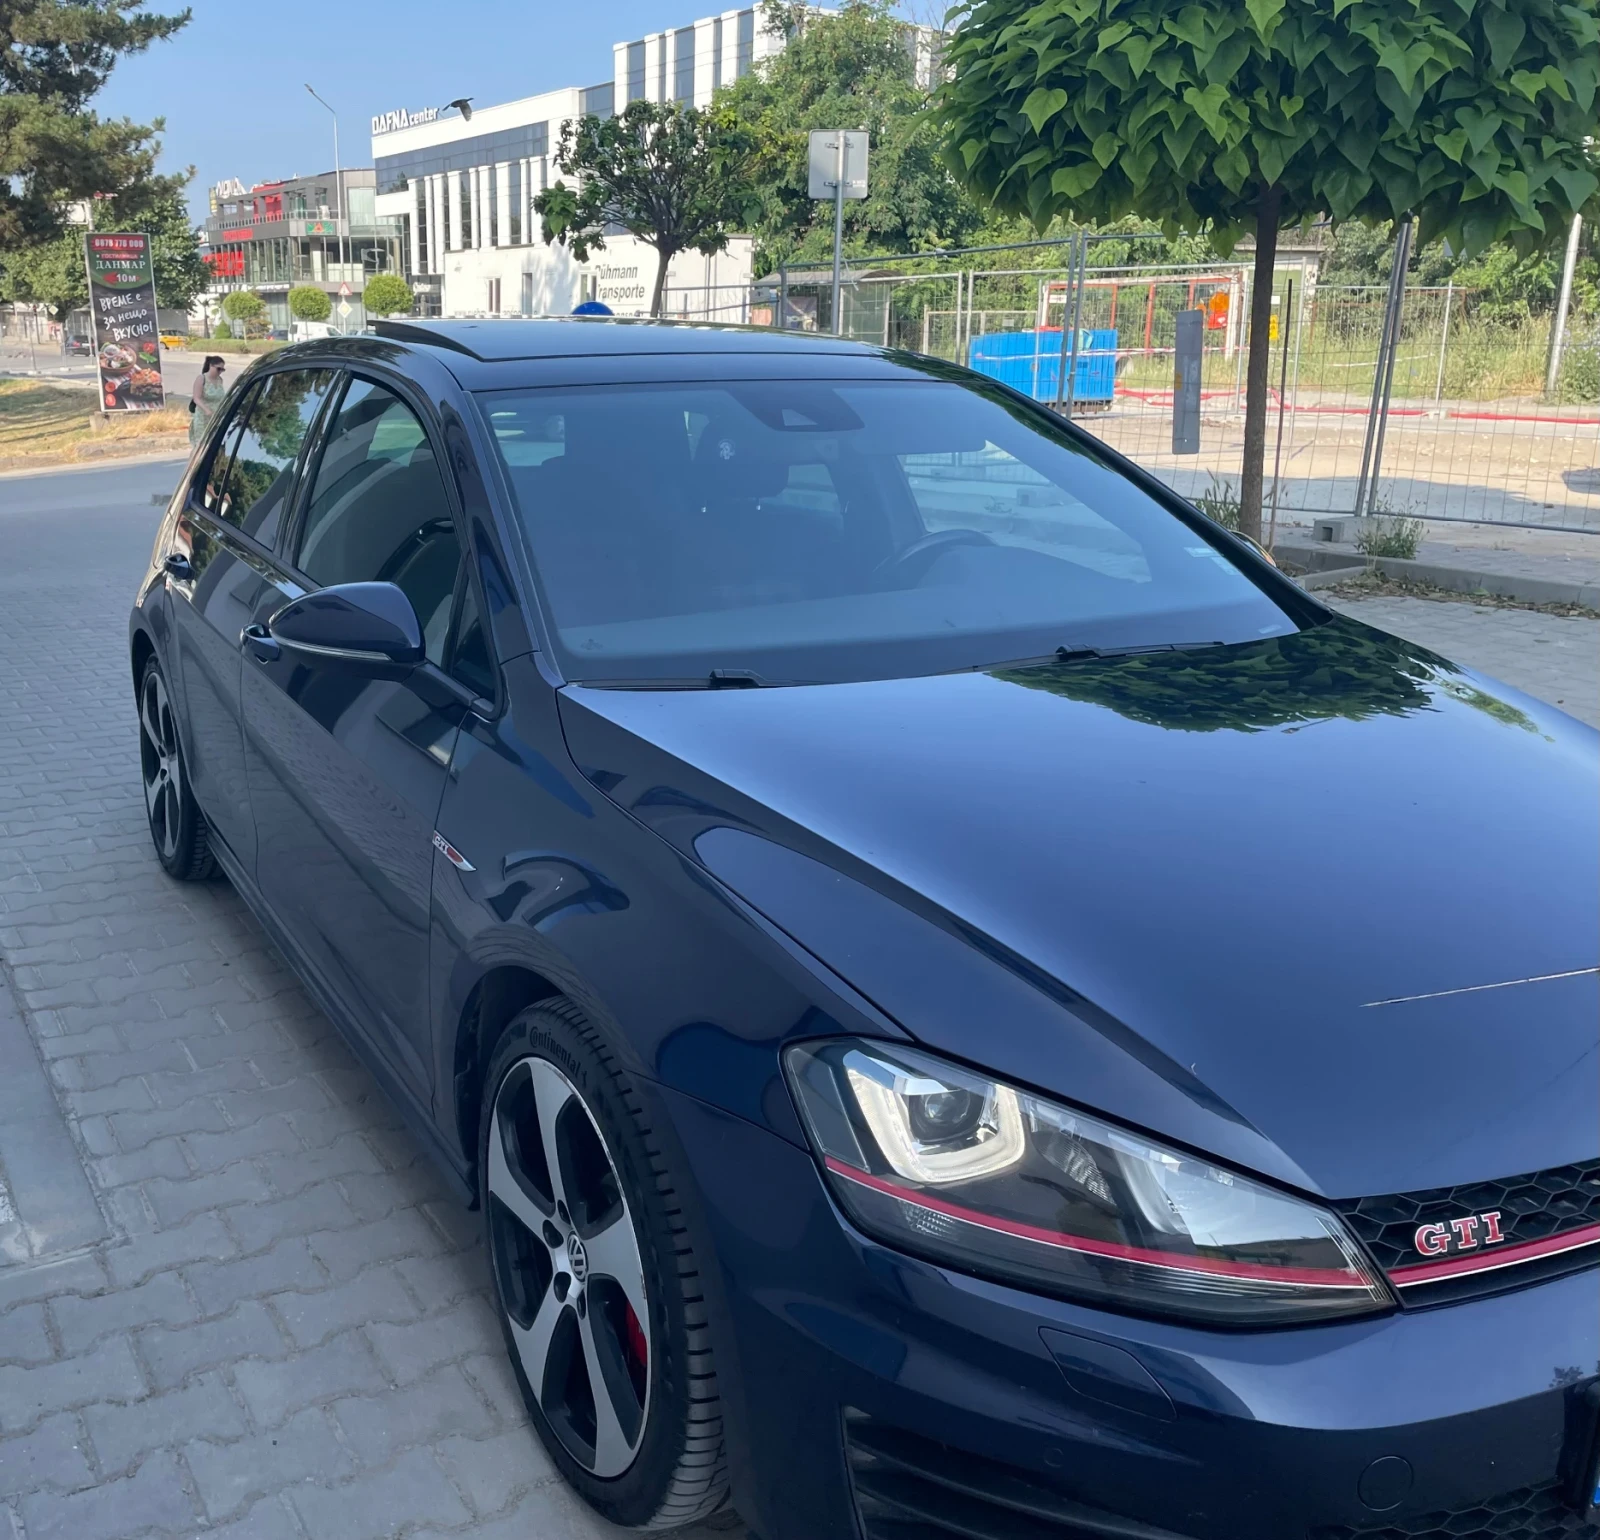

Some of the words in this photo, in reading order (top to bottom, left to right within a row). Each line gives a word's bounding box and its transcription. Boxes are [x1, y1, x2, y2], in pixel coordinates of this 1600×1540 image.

[371, 108, 409, 135] DAFNA
[409, 107, 440, 125] center
[96, 261, 146, 269] ДАНМАР
[99, 293, 134, 312] ВРЕМЕ
[598, 283, 645, 302] ransporte
[112, 321, 153, 341] ВКУСНО!
[529, 1026, 582, 1078] Continental
[1415, 1211, 1505, 1256] GTI
